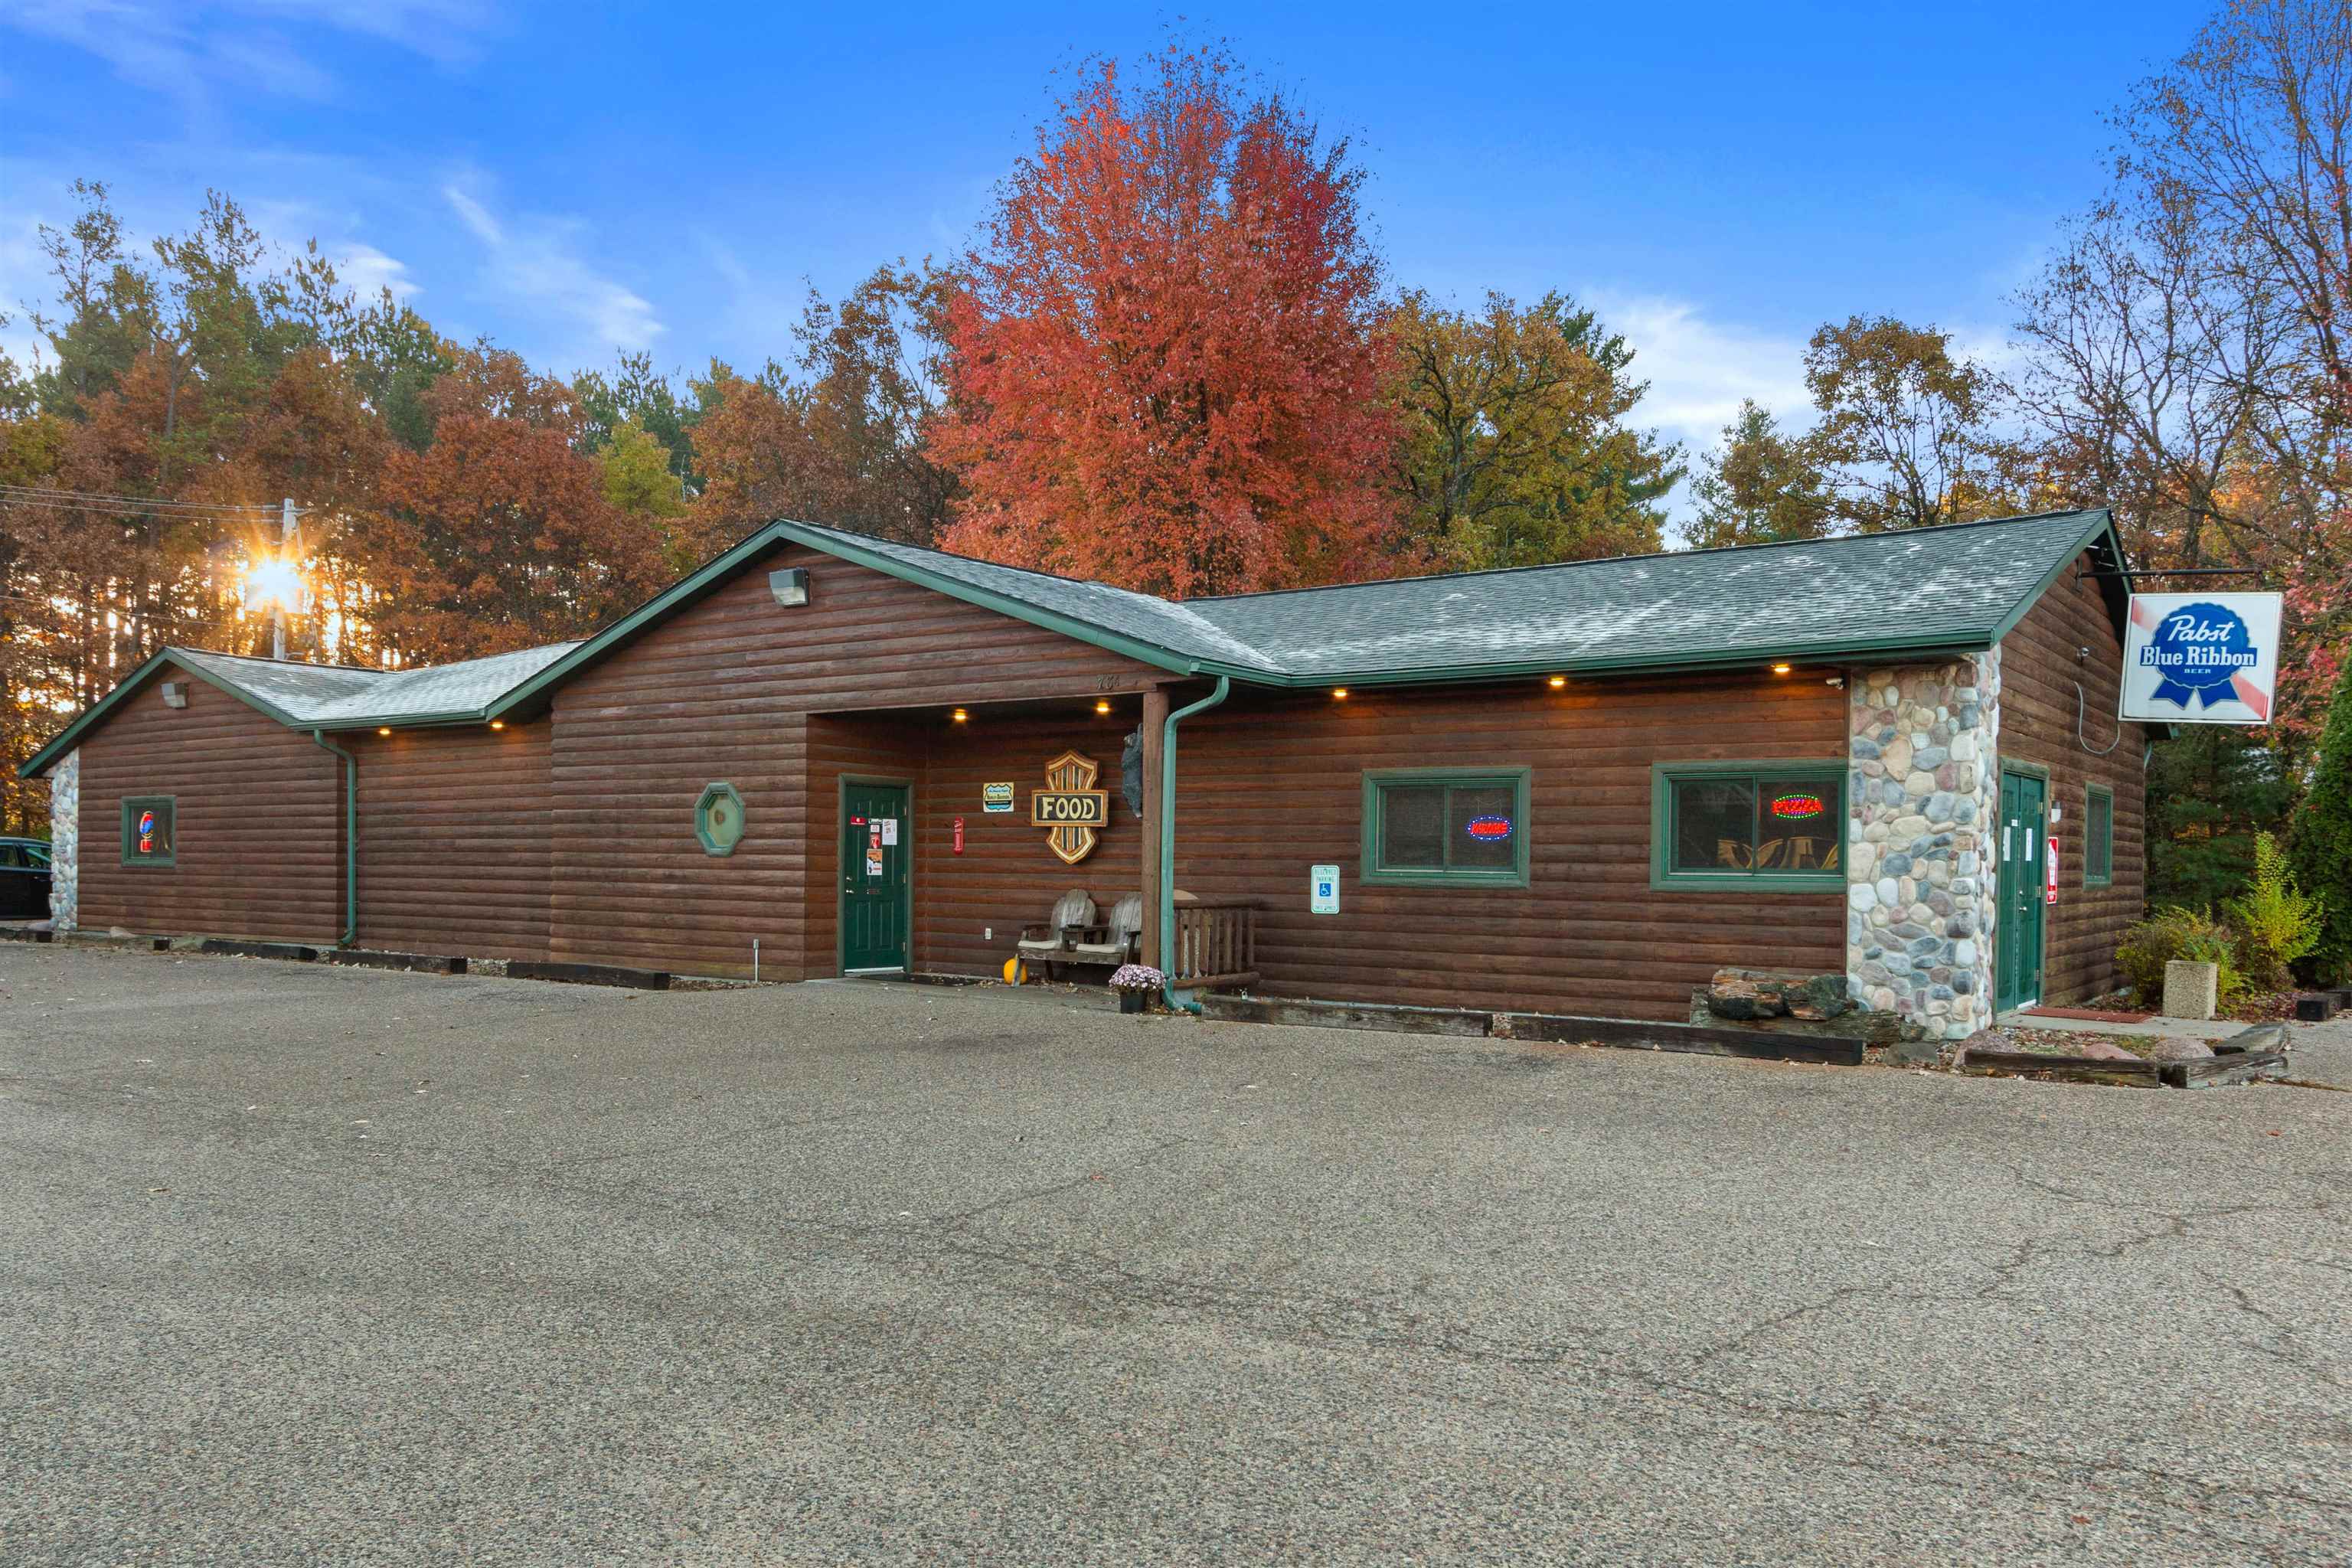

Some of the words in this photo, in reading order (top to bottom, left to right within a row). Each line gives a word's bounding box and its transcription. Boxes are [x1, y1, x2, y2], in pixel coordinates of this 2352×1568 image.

[2167, 615, 2236, 642] Pabst
[2141, 646, 2183, 665] Blue
[2185, 646, 2255, 666] Ribbon
[1042, 796, 1096, 819] FOOD
[1772, 799, 1824, 814] PIZZA
